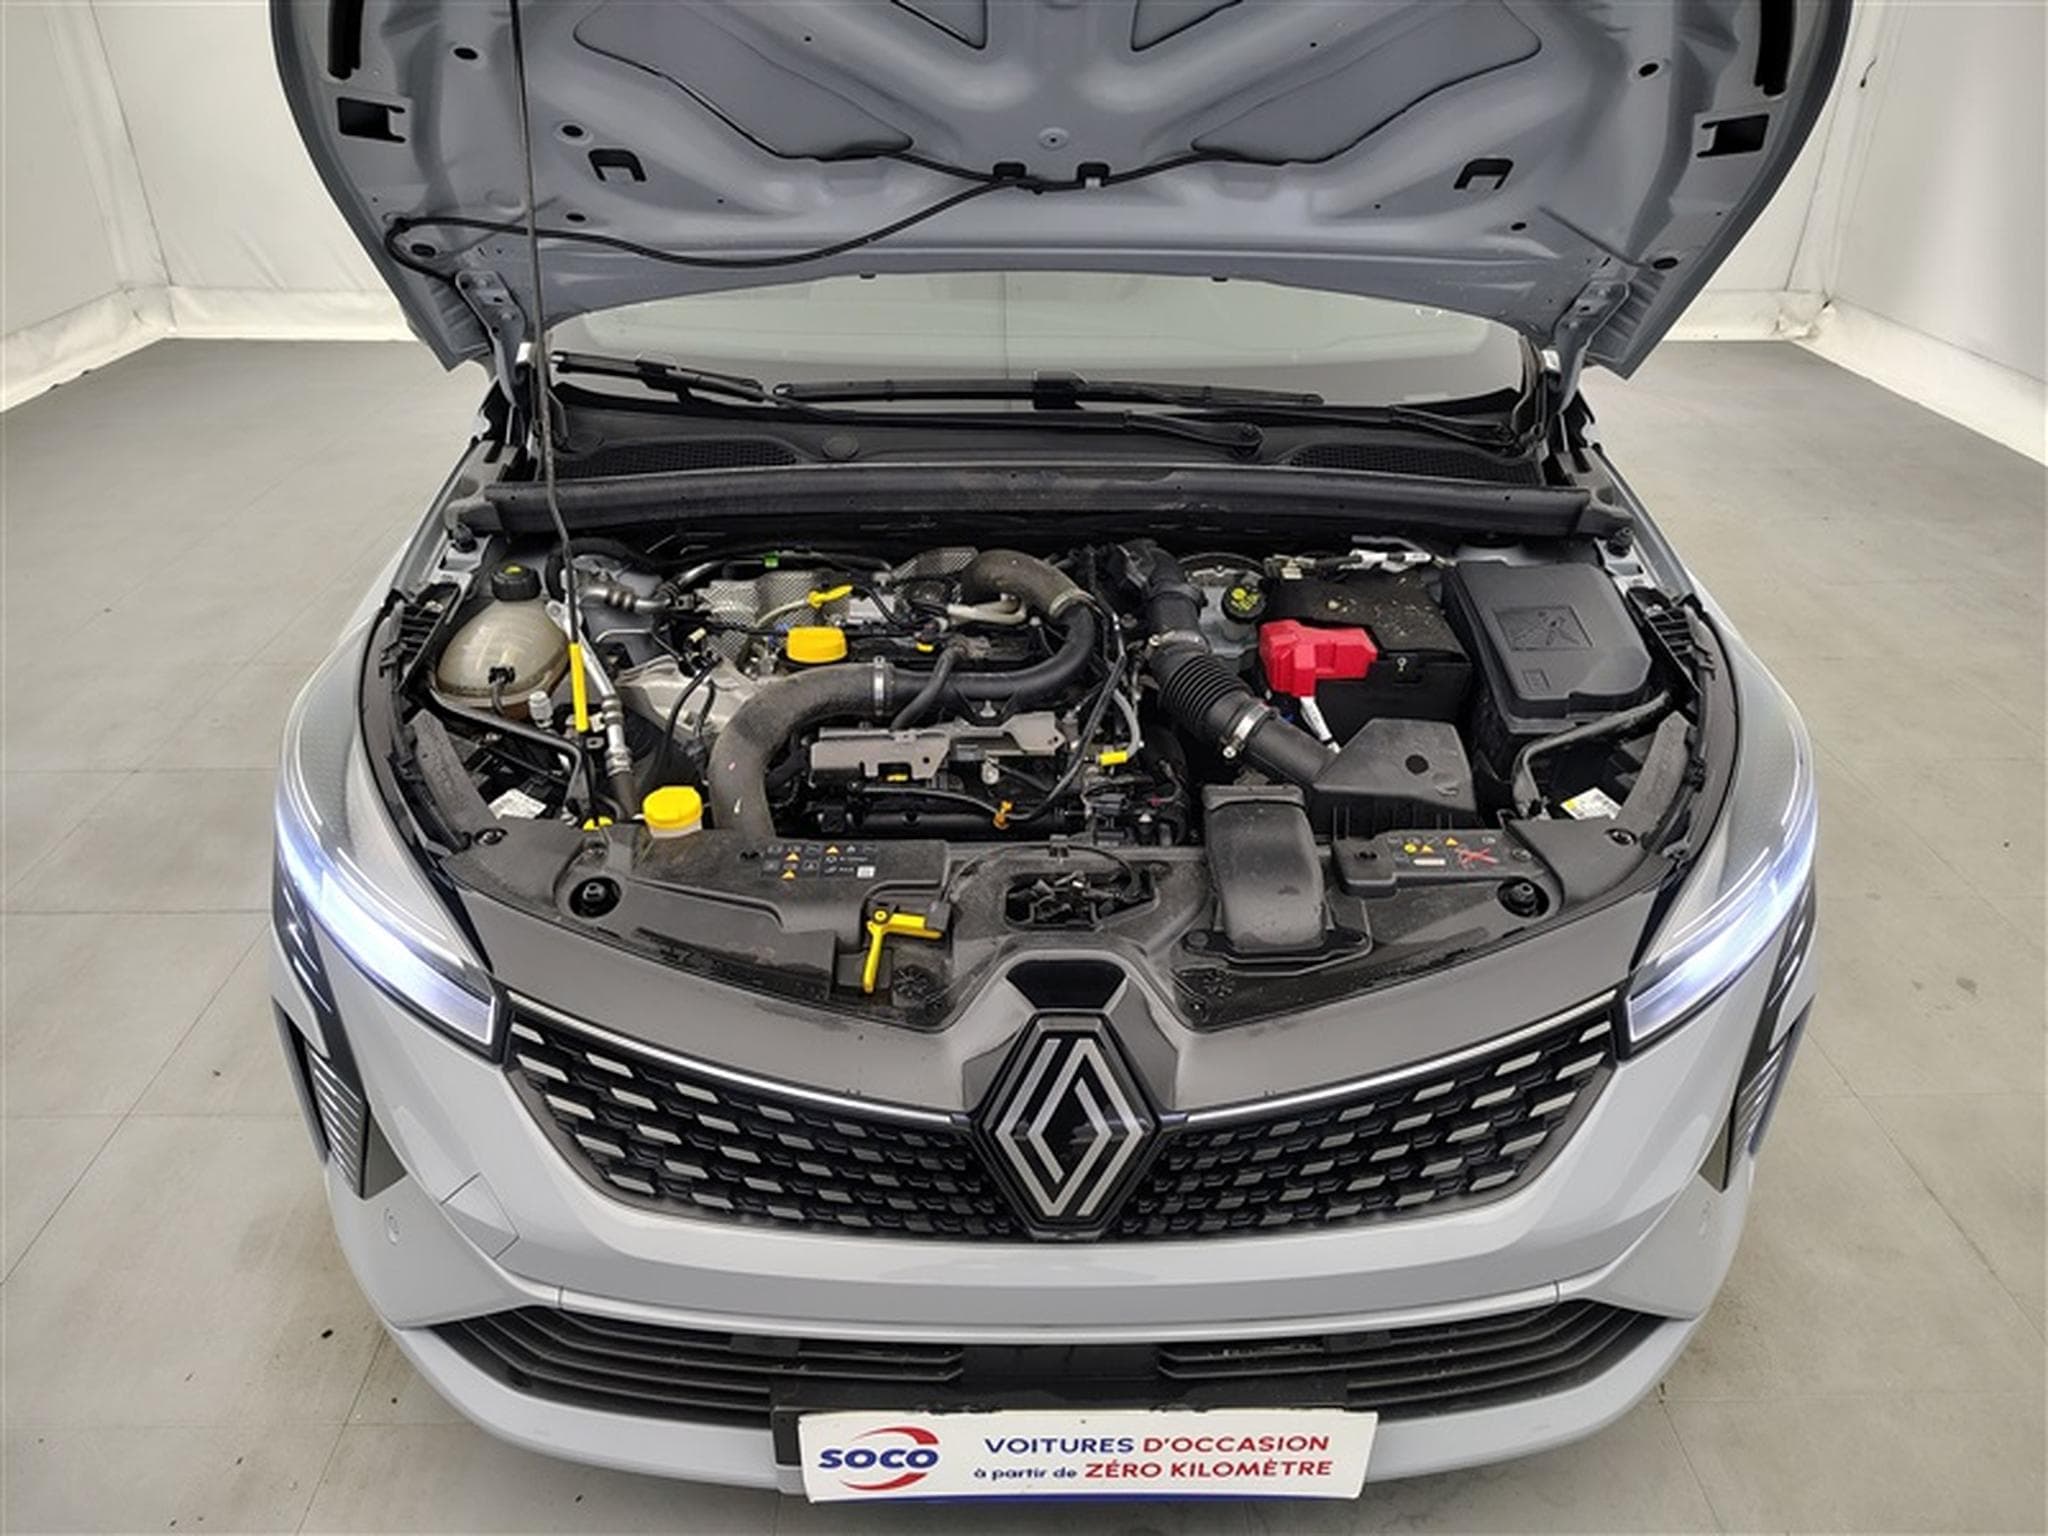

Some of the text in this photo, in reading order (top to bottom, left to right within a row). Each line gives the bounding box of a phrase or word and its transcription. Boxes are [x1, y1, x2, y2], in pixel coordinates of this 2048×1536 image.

[984, 1436, 1330, 1454] VOITURES D'OCCASION
[818, 1448, 939, 1469] SOCO
[973, 1458, 1333, 1482] à partir de ZÉRO KILOMÈTRE
